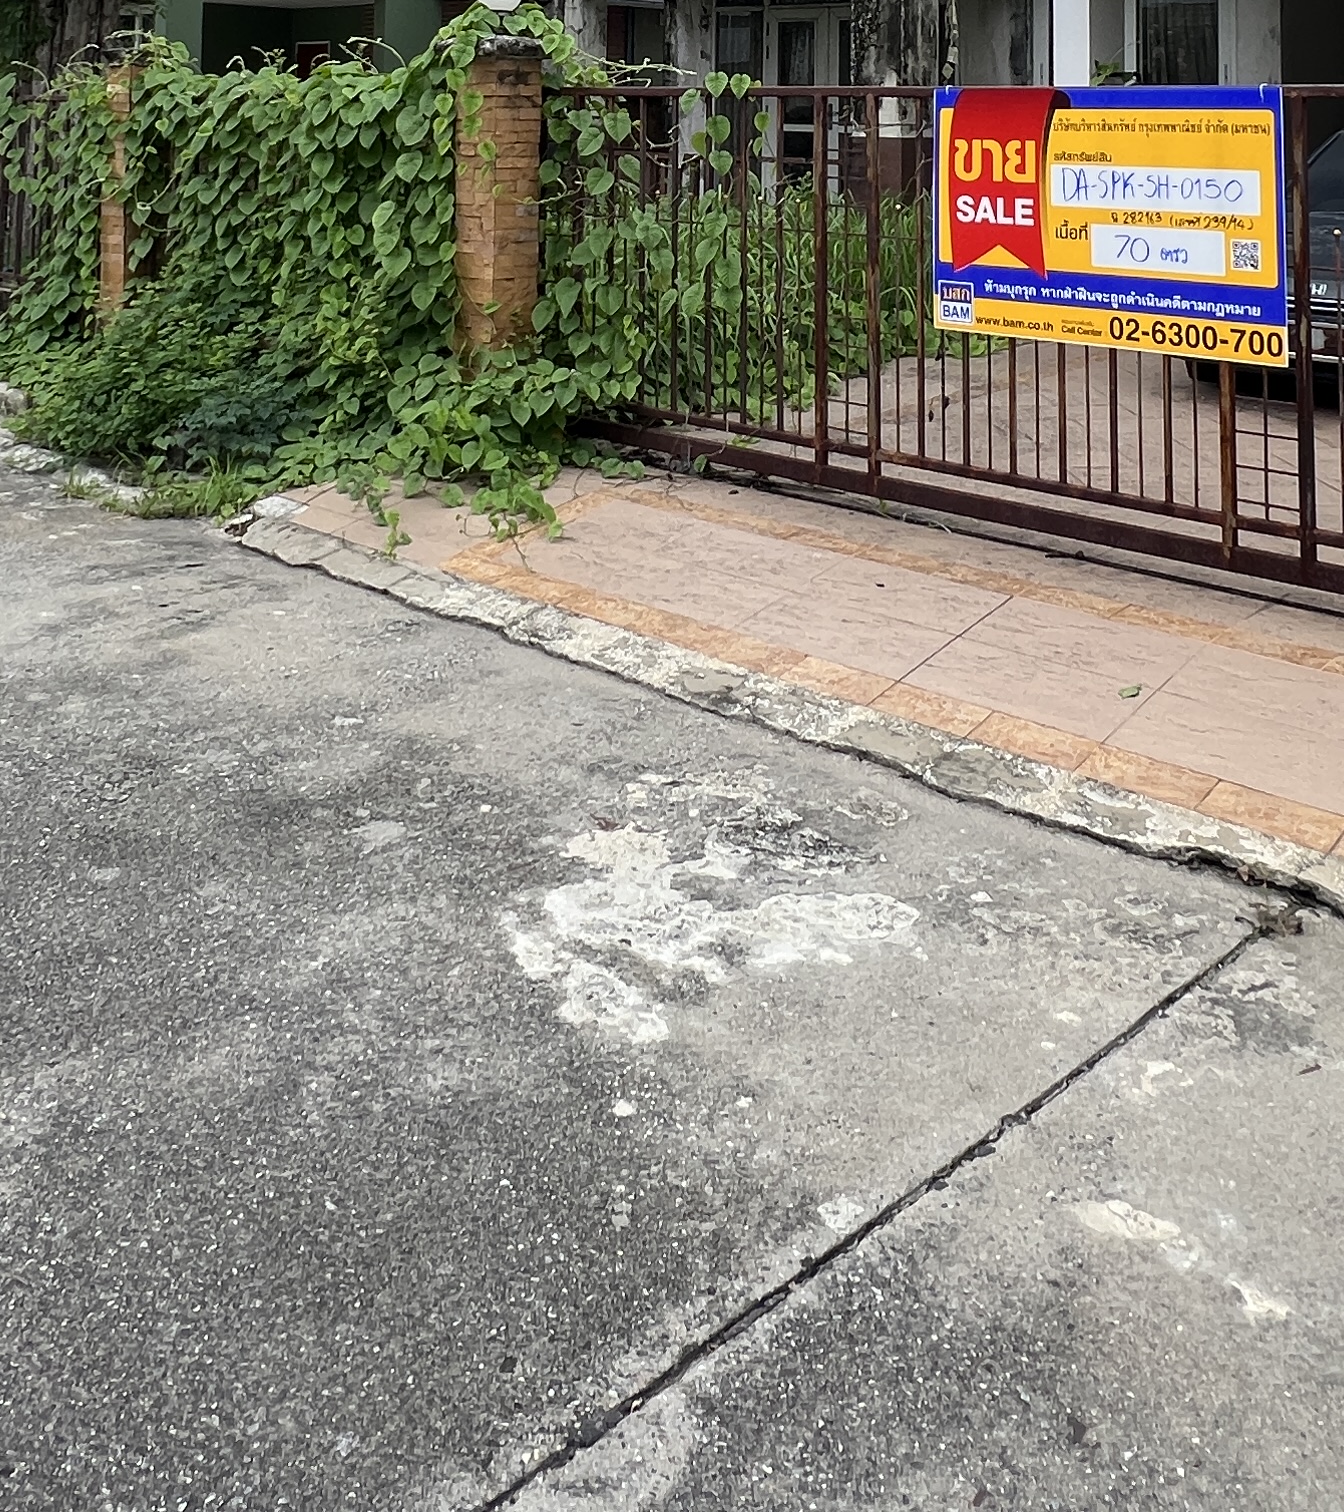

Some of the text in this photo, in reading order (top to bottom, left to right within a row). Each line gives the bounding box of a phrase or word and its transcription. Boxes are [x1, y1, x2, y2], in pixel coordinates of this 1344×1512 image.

[1205, 119, 1229, 134] จำกัด
[1231, 122, 1271, 137] (มหาชน)
[954, 138, 1036, 184] ขาย
[1062, 166, 1244, 203] DA-SPK-SH-0150
[956, 194, 1035, 227] SALE
[1055, 219, 1089, 241] เนื้อที่
[1114, 234, 1151, 263] 70
[942, 286, 971, 302] บสก
[984, 279, 1037, 302] ห้ามบุกรุก
[943, 304, 970, 320] BAM
[976, 316, 1054, 332] www.bam.co.th
[1109, 316, 1284, 358] 02-6300-700
